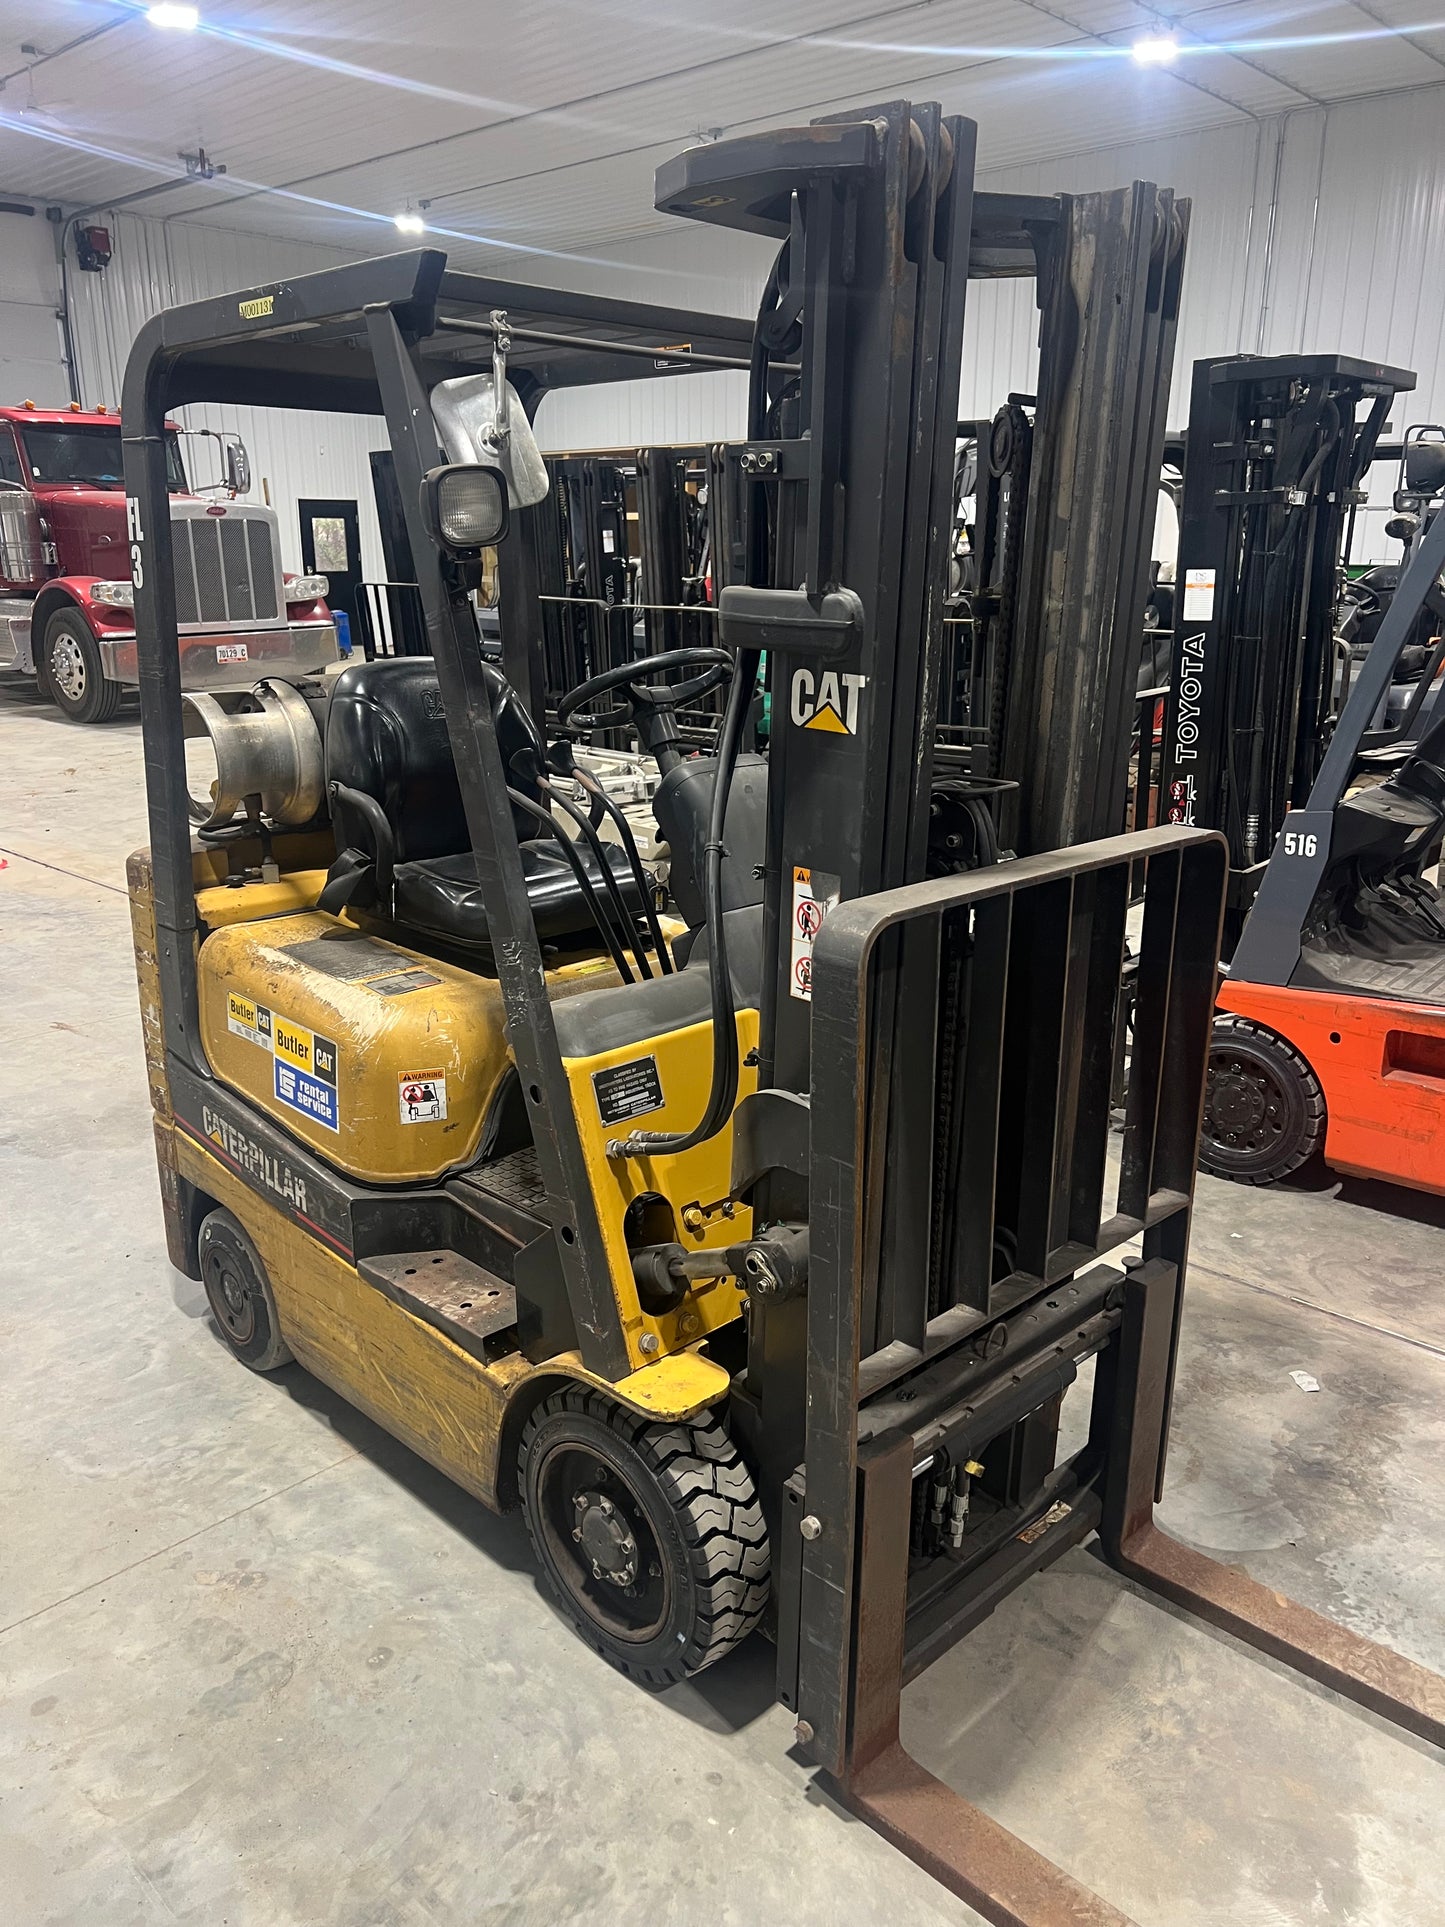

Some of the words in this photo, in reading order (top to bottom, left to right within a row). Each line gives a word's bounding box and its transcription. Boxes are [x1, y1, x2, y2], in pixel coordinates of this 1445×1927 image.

[131, 544, 144, 589] 3
[605, 574, 614, 605] OTA
[790, 668, 866, 735] CAT
[1175, 632, 1206, 764] TOYOTA
[1284, 832, 1318, 858] 516
[231, 999, 254, 1021] Butler
[258, 1011, 270, 1029] CAT
[277, 1029, 309, 1060] Butler
[316, 1048, 333, 1072] CAT
[411, 1071, 443, 1080] WARNING
[297, 1091, 332, 1119] service
[299, 1080, 329, 1105] rental
[203, 1105, 308, 1213] CATERPILLAR
